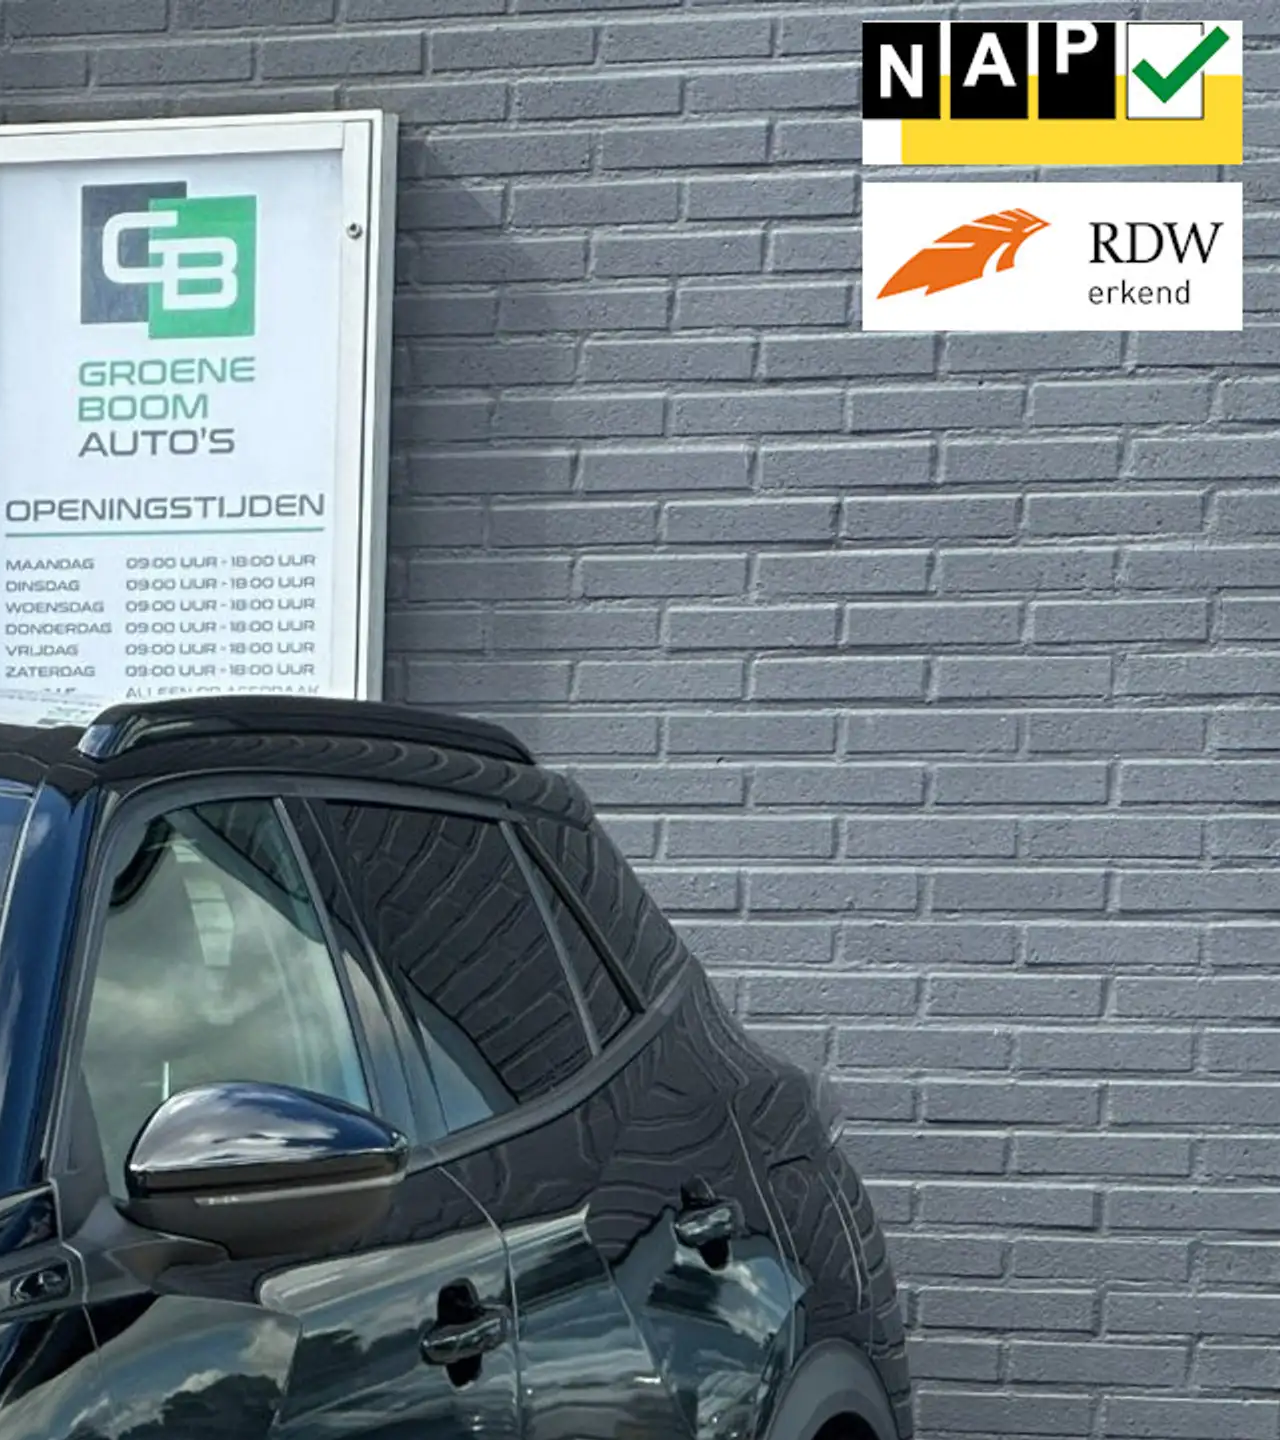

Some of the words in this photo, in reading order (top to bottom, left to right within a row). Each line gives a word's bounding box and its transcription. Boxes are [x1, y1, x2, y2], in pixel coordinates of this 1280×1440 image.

[78, 356, 256, 388] GROENE
[78, 393, 209, 422] BOOM
[78, 427, 236, 458] AUTO'S
[5, 493, 325, 523] OPENINGSTIJDEN
[5, 558, 95, 571] MAANDAG
[180, 556, 218, 568] UUR
[278, 554, 316, 567] UUR
[5, 580, 81, 592] DINSDAG
[180, 578, 218, 590] UUR
[278, 576, 316, 588] UUR
[5, 601, 105, 614] WOENSDAG
[180, 600, 217, 612] UUR
[278, 598, 316, 610] UUR
[5, 623, 113, 635] DONDERDAG
[180, 622, 217, 633] UUR
[278, 620, 316, 632] UUR
[5, 644, 79, 657] VRIJDAG
[179, 643, 217, 655] UUR
[278, 642, 316, 654] UUR
[5, 666, 96, 678] ZATERDAG
[179, 665, 216, 677] UUR
[277, 664, 315, 676] UUR
